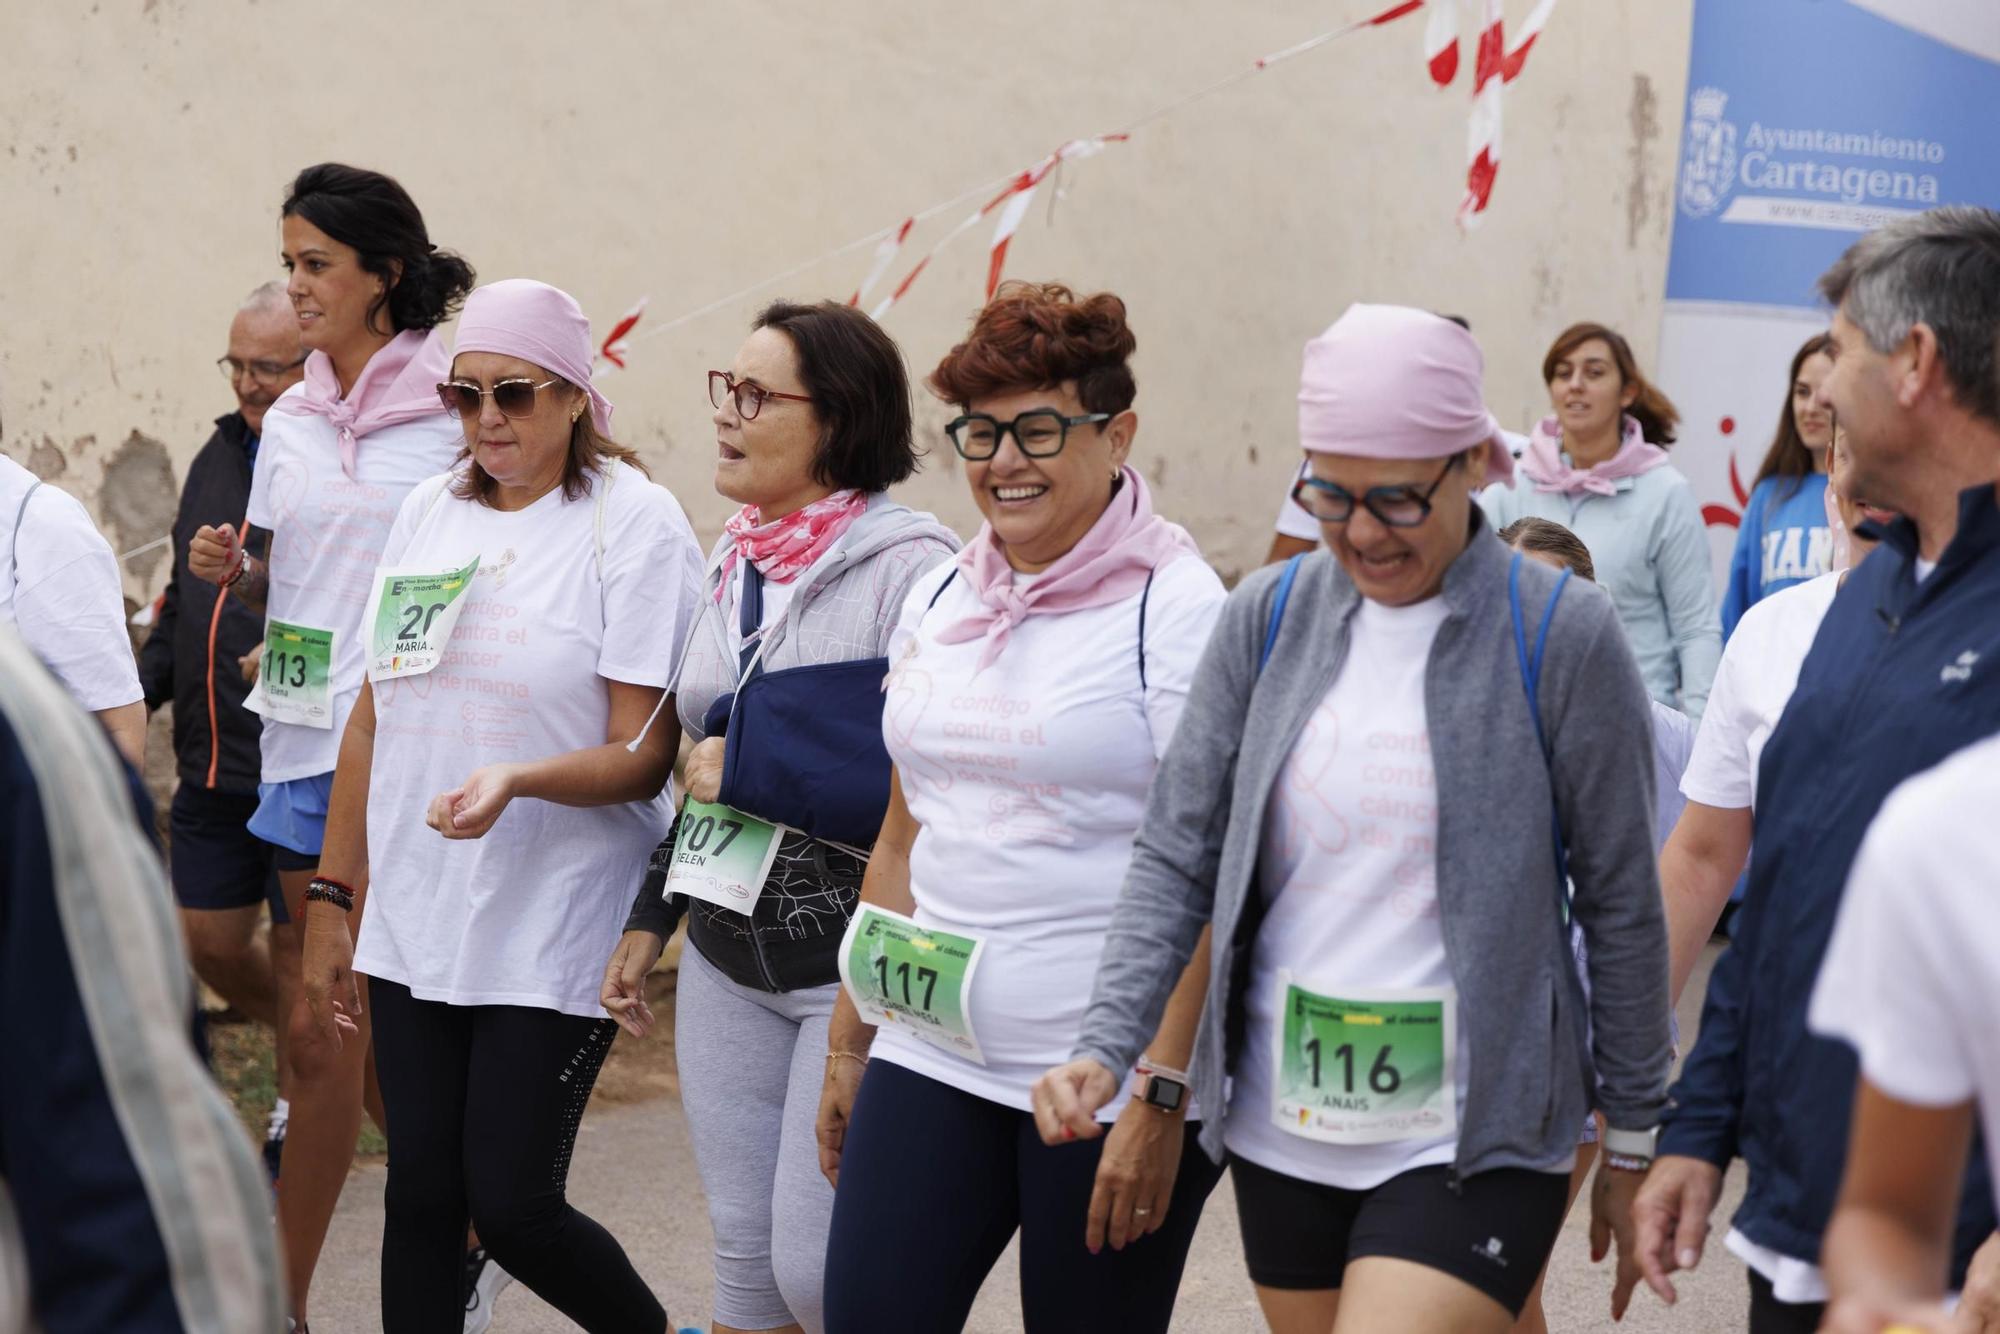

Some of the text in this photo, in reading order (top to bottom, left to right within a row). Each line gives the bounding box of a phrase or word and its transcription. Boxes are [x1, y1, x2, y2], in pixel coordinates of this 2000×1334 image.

[1744, 121, 1945, 163] Ayuntamiento
[1740, 152, 1939, 204] Cartagena
[395, 641, 428, 654] MARIA
[505, 627, 528, 646] el
[265, 649, 306, 688] 113
[439, 672, 530, 699] de mama
[950, 691, 1032, 719] contigo
[942, 720, 1047, 747] contra el
[875, 955, 938, 1011] 117
[559, 1068, 574, 1082] BE
[572, 1047, 587, 1066] FIT
[1305, 1037, 1402, 1094] 116
[1322, 1095, 1370, 1112] ANAIS
